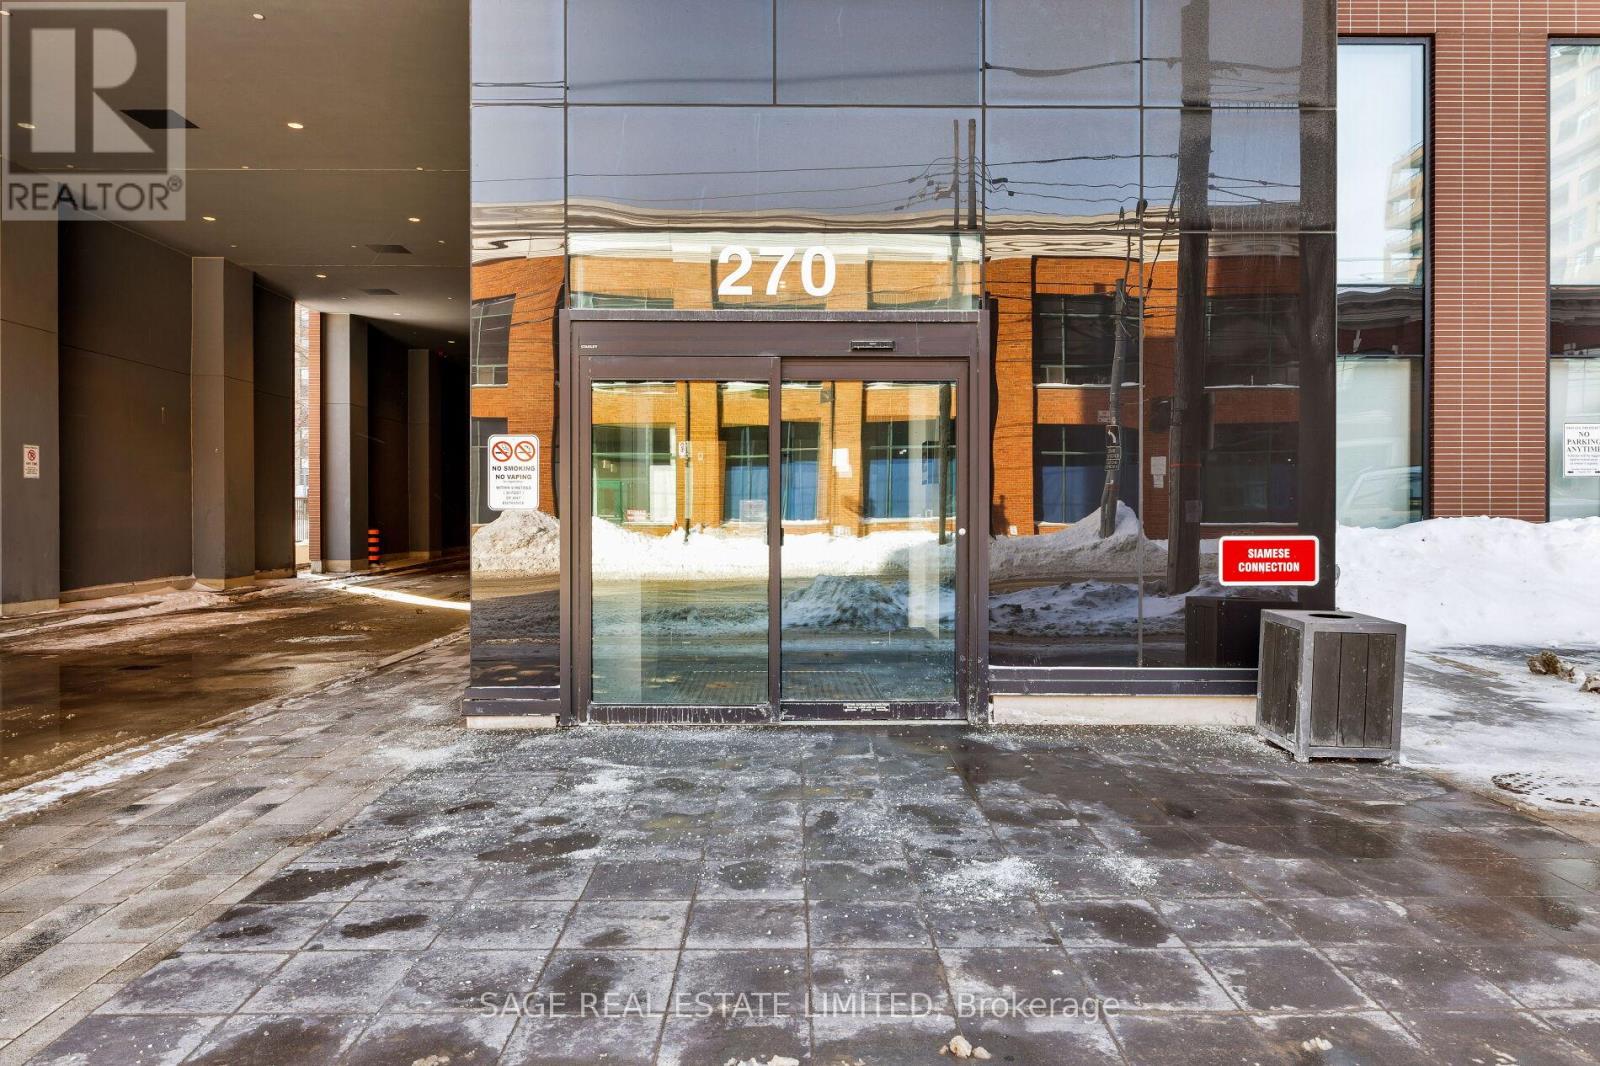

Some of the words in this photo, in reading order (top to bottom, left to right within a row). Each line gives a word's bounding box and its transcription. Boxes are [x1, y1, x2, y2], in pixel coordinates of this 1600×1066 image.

[718, 245, 836, 296] 270
[1247, 548, 1290, 559] SIAMESE
[1238, 562, 1300, 573] CONNECTION
